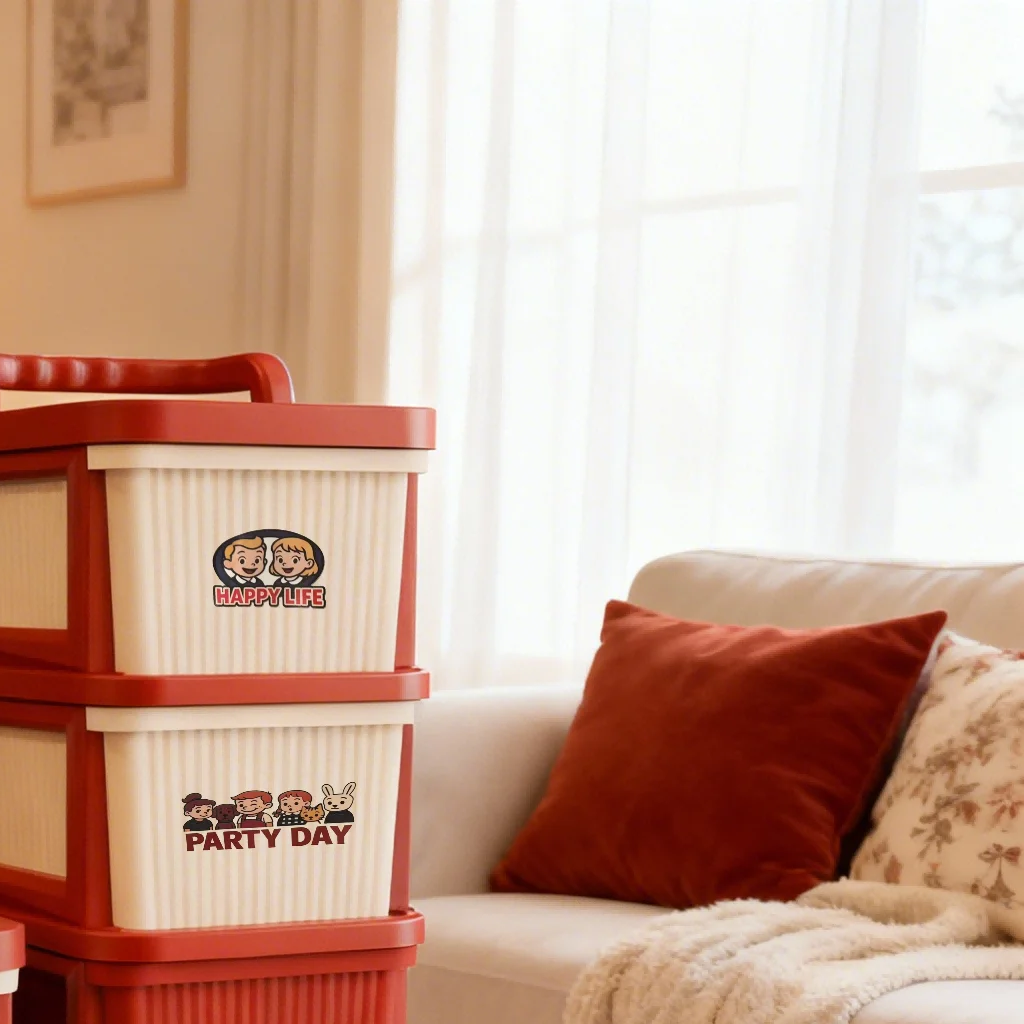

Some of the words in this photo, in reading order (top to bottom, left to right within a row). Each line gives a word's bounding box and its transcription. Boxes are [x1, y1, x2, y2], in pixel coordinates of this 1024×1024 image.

[215, 587, 281, 605] HAPPY
[283, 587, 324, 606] LIFE
[185, 828, 281, 851] PARTY
[291, 824, 352, 847] DAY
